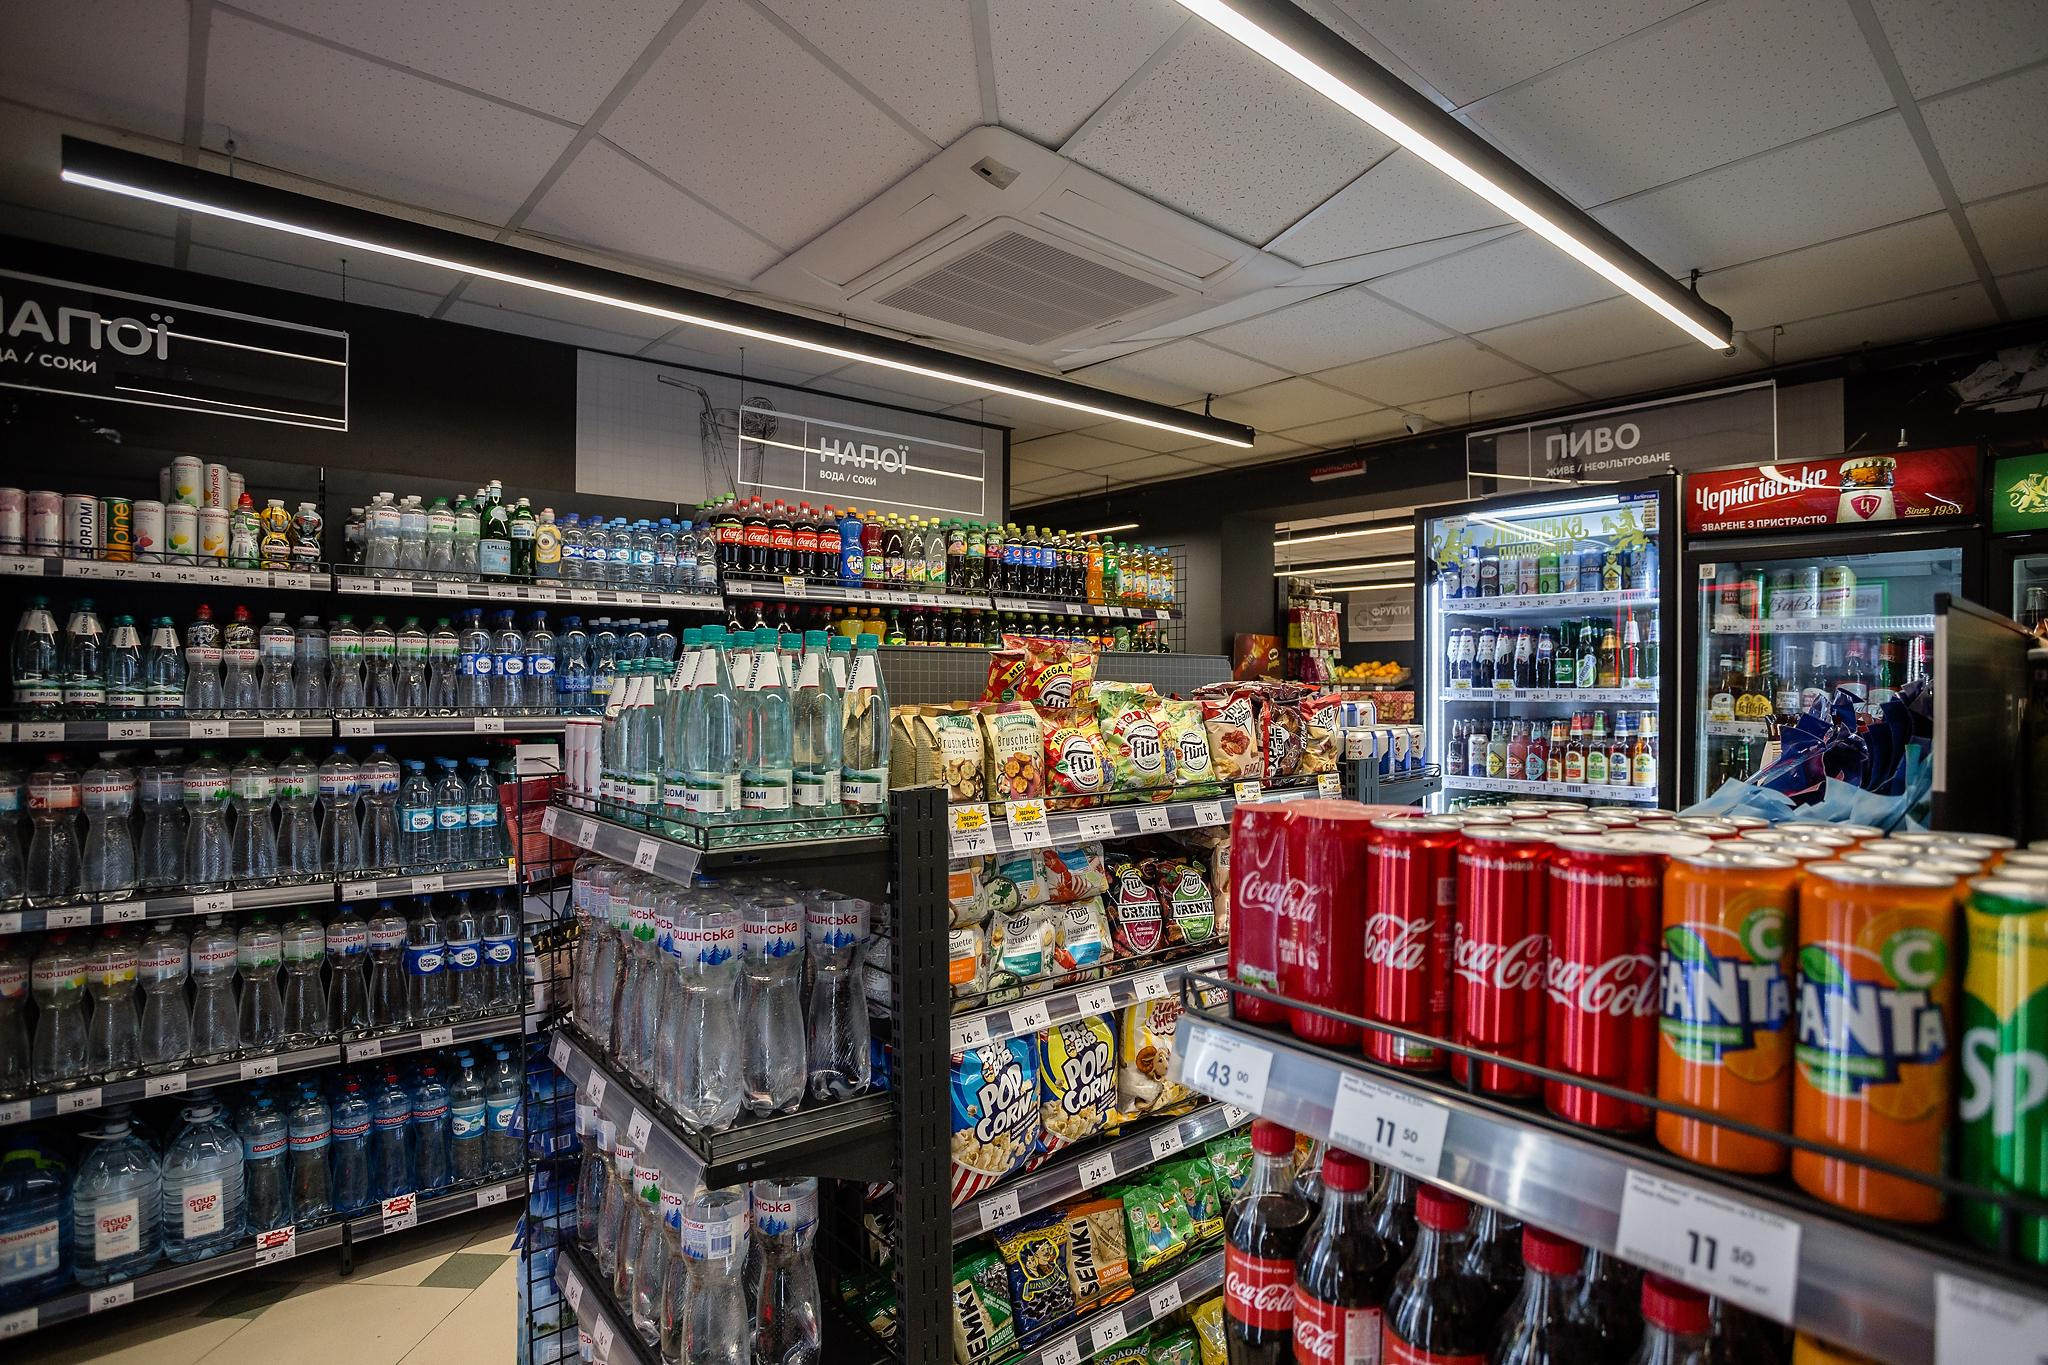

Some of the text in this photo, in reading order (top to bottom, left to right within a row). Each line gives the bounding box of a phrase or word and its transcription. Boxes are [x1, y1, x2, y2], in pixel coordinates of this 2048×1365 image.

[0, 296, 175, 360] АПОЇ
[40, 354, 97, 374] СОКИ
[1546, 423, 1641, 461] ПИВО
[820, 437, 909, 475] НАПОЇ
[1546, 464, 1576, 477] ЖИВЕ
[1584, 451, 1672, 473] НЕФІЛЬТРОВАНЕ
[819, 469, 845, 483] ВОДА
[852, 474, 877, 486] СОКИ
[1701, 520, 1746, 532] ЗВАРЕНЕ
[1756, 514, 1828, 528] ПРИСТРАСТЮ
[1371, 606, 1411, 616] ФРУКТИ
[748, 653, 762, 689] BORJOMI
[1039, 666, 1064, 683] MEGA
[997, 733, 1040, 748] Bruschette
[1148, 816, 1157, 826] 15
[1204, 813, 1213, 821] 10
[1090, 824, 1100, 835] 15
[1024, 832, 1033, 842] 17
[967, 840, 977, 850] 17
[62, 916, 74, 924] 17
[117, 911, 129, 919] 16
[1365, 913, 1434, 971] Cola
[1749, 919, 1783, 960] C
[1892, 938, 1938, 986] C
[1146, 985, 1155, 994] 15
[1090, 998, 1100, 1009] 16
[1024, 1015, 1035, 1026] 16
[961, 1032, 973, 1044] 16
[1062, 1042, 1109, 1091] POP
[1206, 1060, 1249, 1087] 43 00
[978, 1062, 1024, 1118] POP
[1064, 1069, 1117, 1115] CORN
[72, 1099, 84, 1107] 18
[976, 1086, 1034, 1143] CORN
[1232, 1107, 1242, 1119] 33
[1376, 1116, 1418, 1148] 11 50
[1160, 1139, 1171, 1151] 28
[1090, 1168, 1101, 1180] 24
[189, 1194, 217, 1208] aqua
[992, 1205, 1004, 1219] 24
[102, 1213, 132, 1228] aqua
[1687, 1229, 1756, 1271] 11 50
[1069, 1219, 1101, 1297] SEMKI
[102, 1295, 117, 1304] 30
[1159, 1297, 1170, 1309] 22
[1103, 1328, 1113, 1340] 15
[1055, 1353, 1066, 1365] 18
